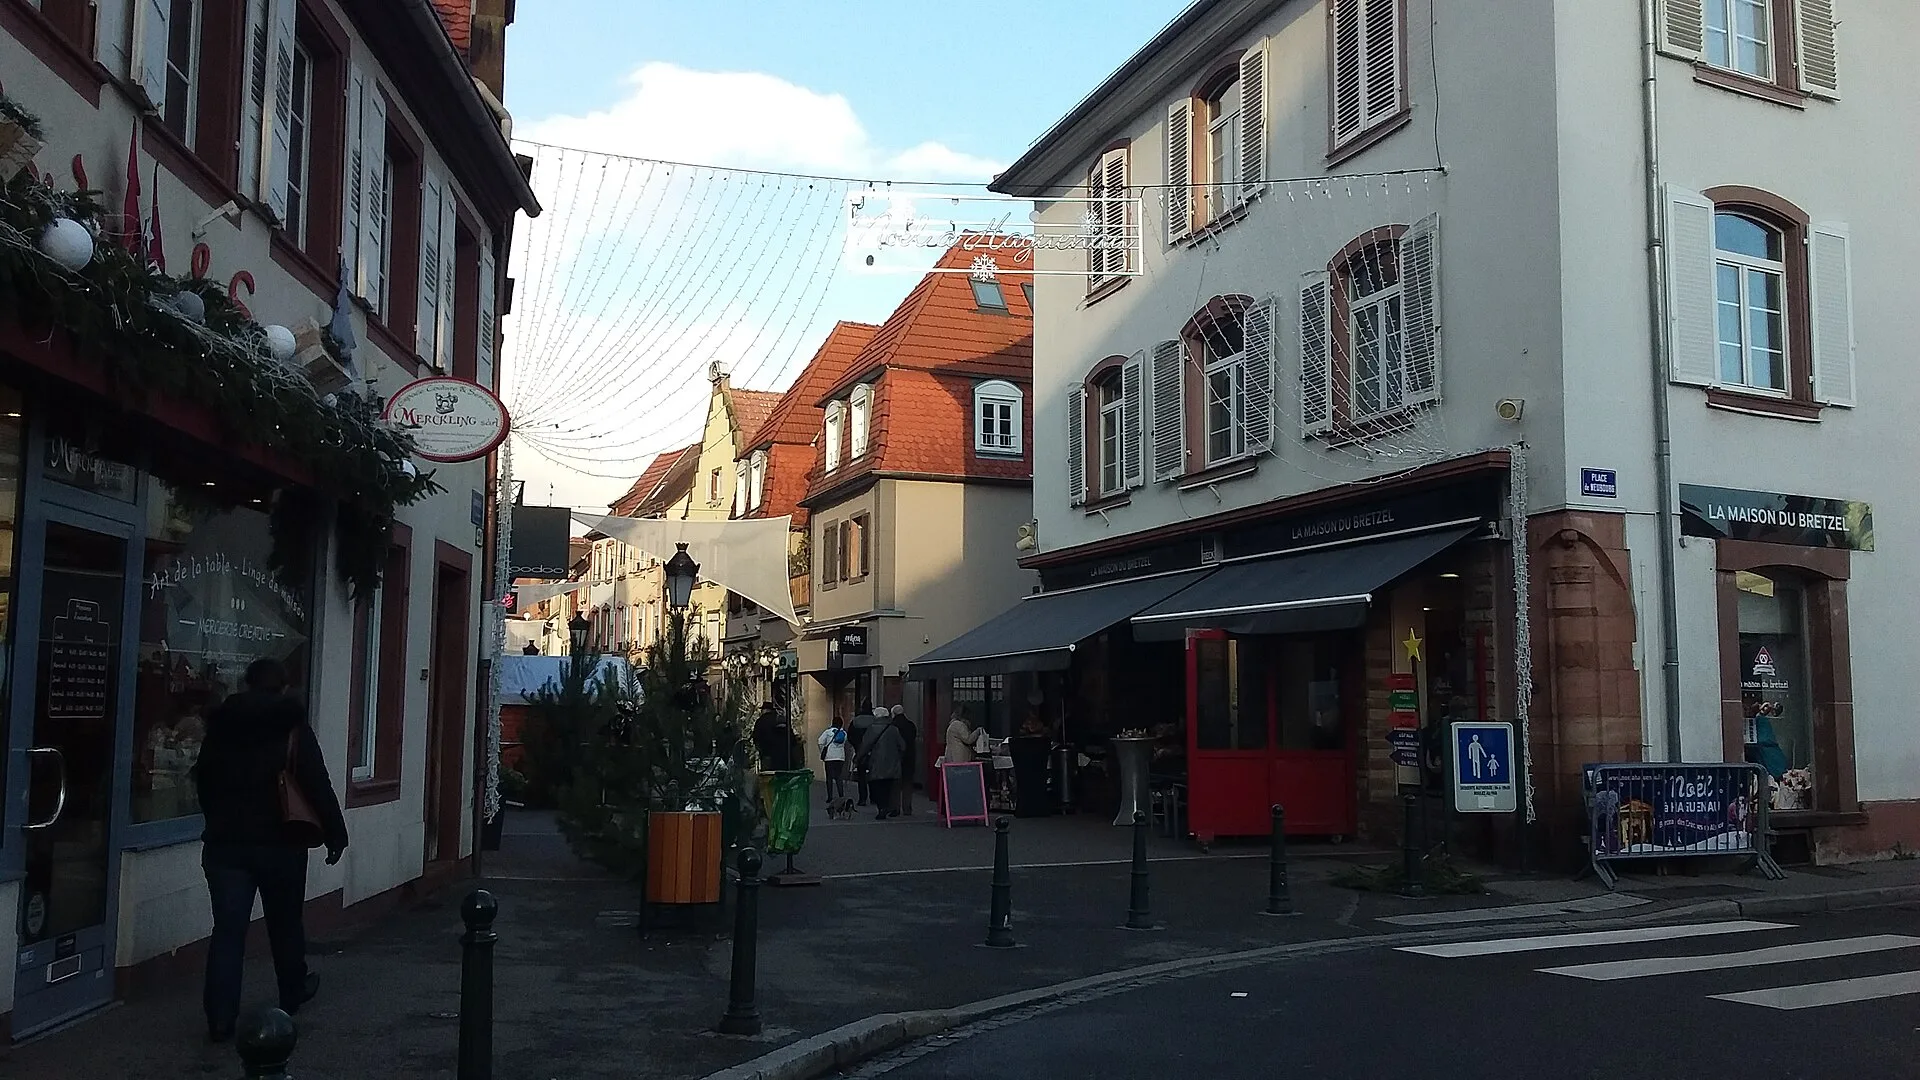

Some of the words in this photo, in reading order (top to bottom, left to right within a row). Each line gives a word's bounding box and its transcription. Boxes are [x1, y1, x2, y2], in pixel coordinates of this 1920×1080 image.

[1591, 473, 1607, 482] PLACE
[1291, 527, 1303, 539] LA
[1303, 520, 1337, 537] MAISON
[1338, 517, 1351, 532] DU
[1353, 509, 1395, 529] BRETZEL
[1708, 504, 1725, 520] LA
[1727, 506, 1776, 525] MAISON
[1779, 512, 1796, 526] DU
[1798, 513, 1850, 532] BRETZEL
[1090, 567, 1097, 577] LA
[1097, 563, 1118, 576] MAISON
[1118, 562, 1127, 572] DU
[1127, 556, 1152, 570] BRETZEL
[151, 568, 170, 599] Art
[174, 558, 187, 582] de
[190, 555, 201, 578] la
[205, 552, 230, 575] table
[242, 557, 266, 587] Linge
[268, 570, 278, 593] de
[281, 588, 305, 622] maison
[1669, 774, 1713, 798] Noël
